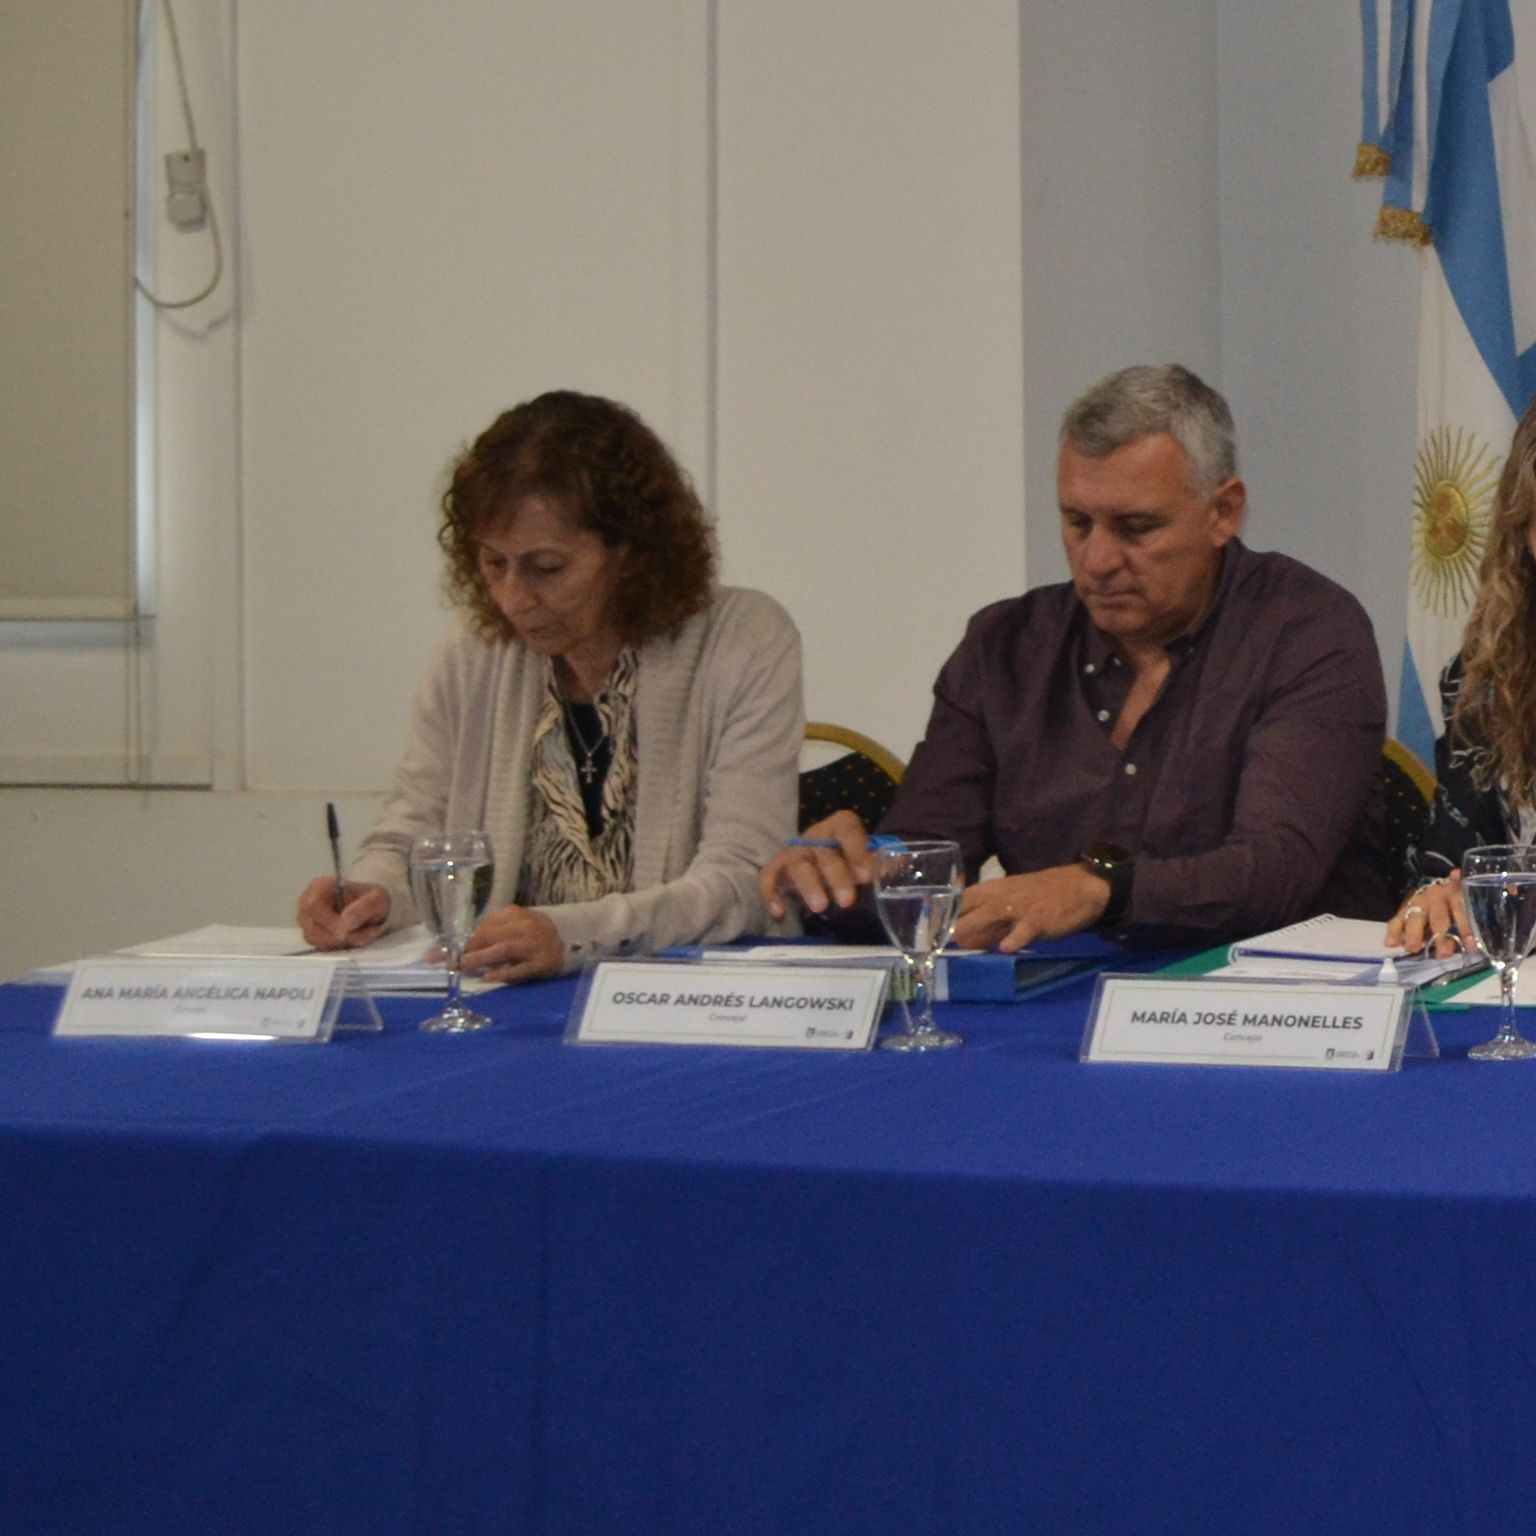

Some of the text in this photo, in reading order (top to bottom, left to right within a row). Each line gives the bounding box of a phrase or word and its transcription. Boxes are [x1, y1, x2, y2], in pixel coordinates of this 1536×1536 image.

[82, 984, 314, 1000] ANA MARÍA ANGÉLICA NAPOLI
[612, 991, 855, 1011] OSCAR ANDRÉS LANGOWSKI
[1131, 1008, 1364, 1030] MARÍA JOSÉ MANONELLES
